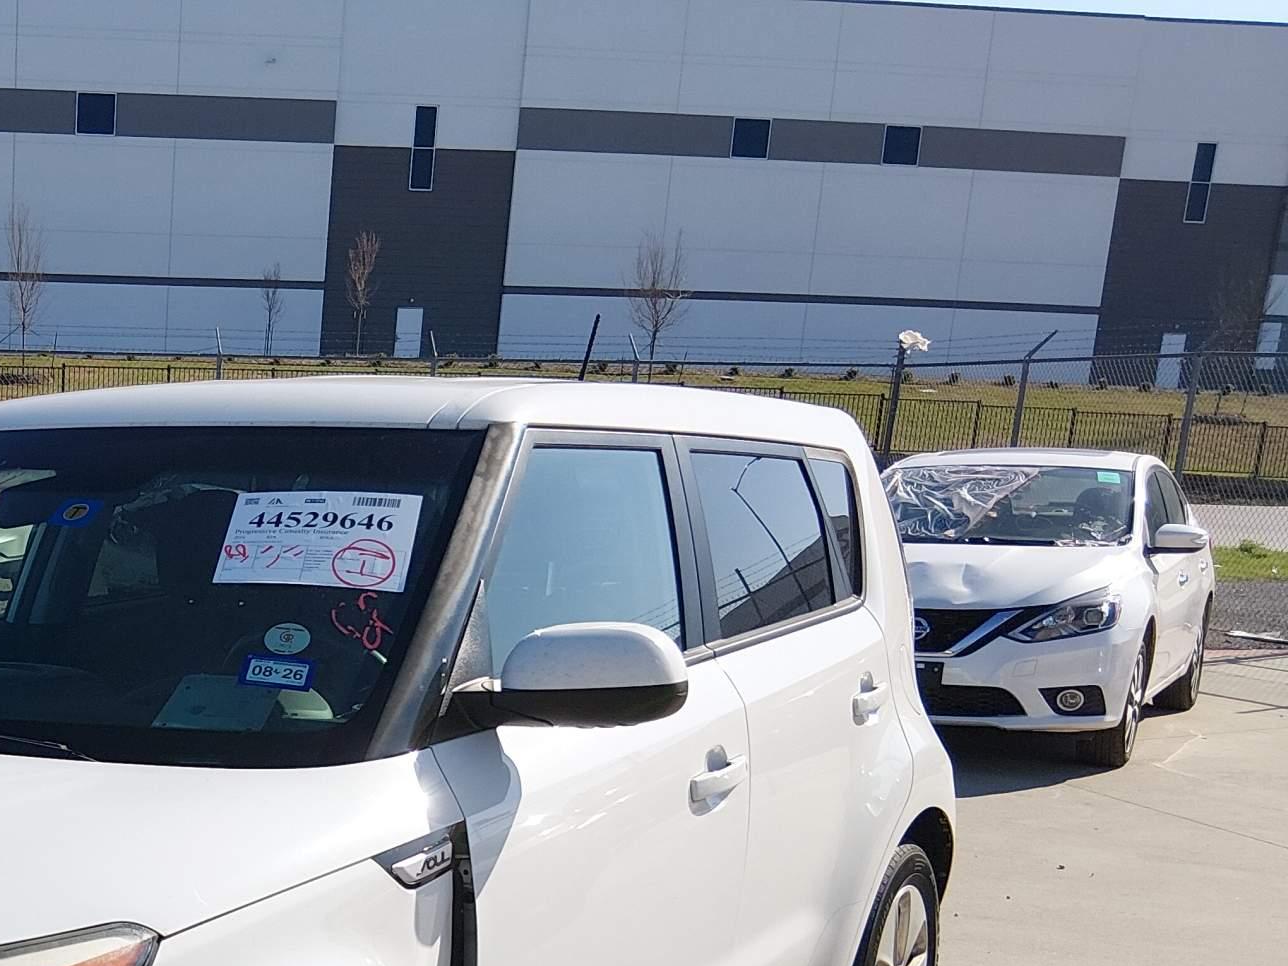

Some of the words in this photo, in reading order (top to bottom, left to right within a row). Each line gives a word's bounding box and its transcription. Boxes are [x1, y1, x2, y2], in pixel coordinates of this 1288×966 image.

[249, 511, 399, 532] 44529646
[251, 664, 274, 677] 08
[281, 667, 304, 681] 26
